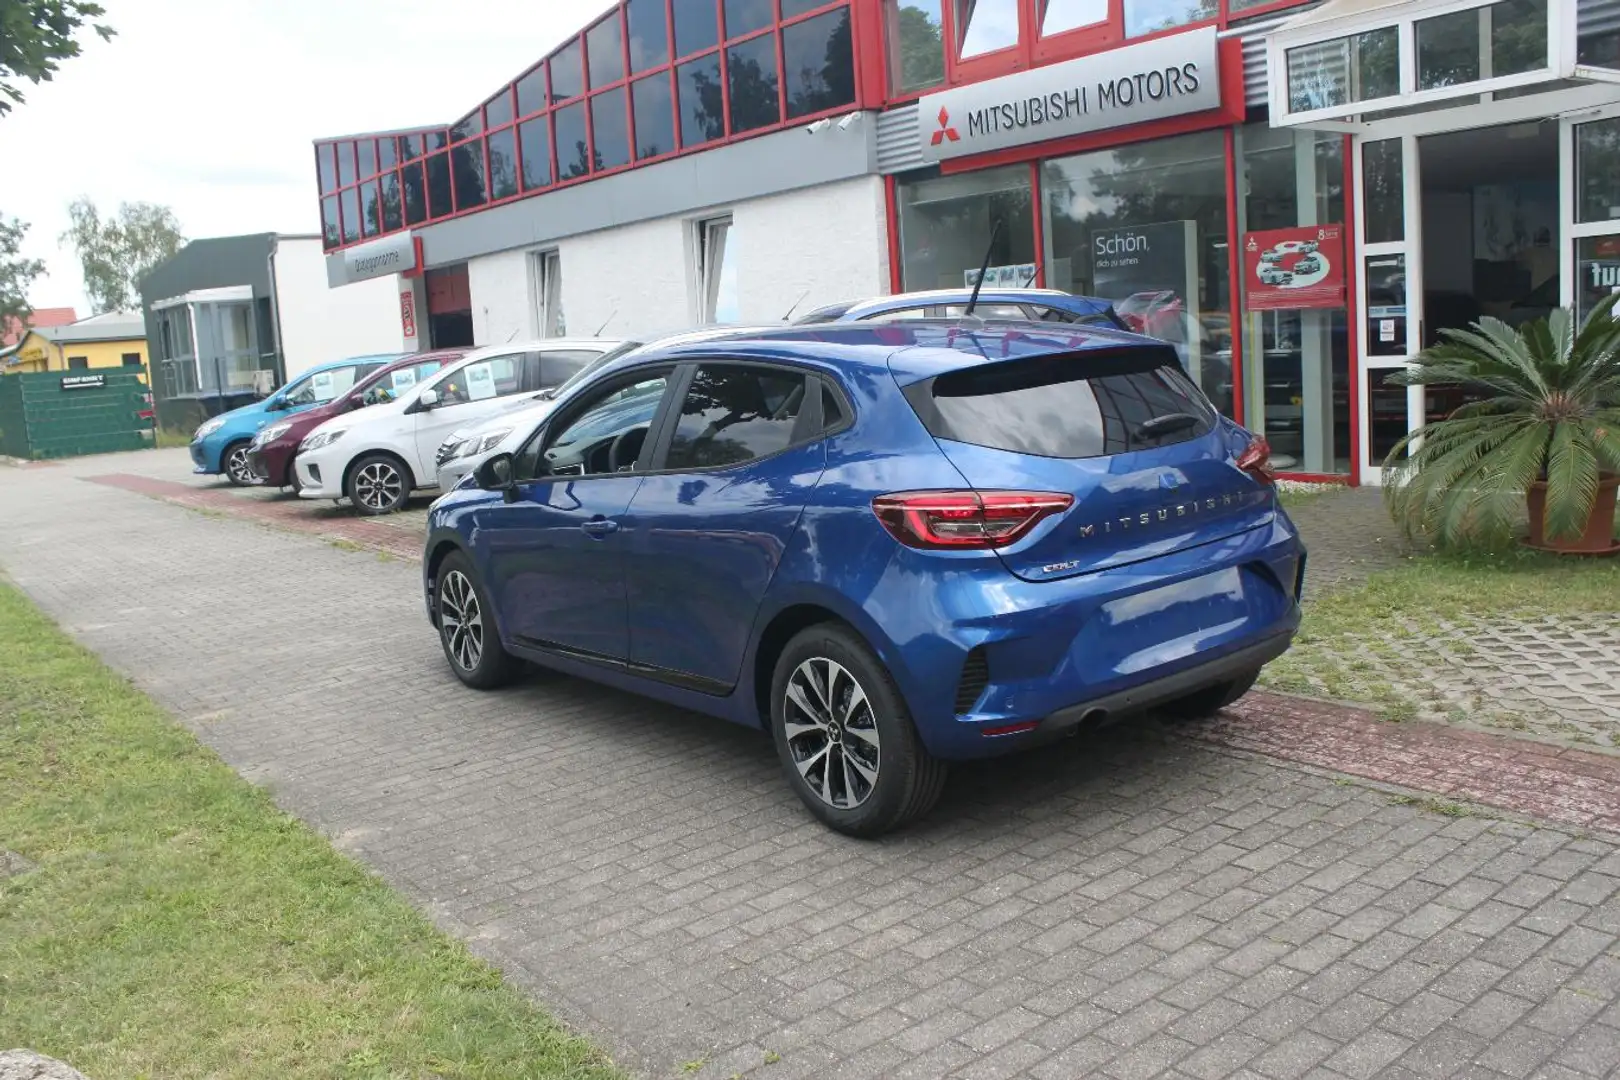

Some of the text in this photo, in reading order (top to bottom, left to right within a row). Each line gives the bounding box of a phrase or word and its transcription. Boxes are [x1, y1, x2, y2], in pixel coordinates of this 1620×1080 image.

[967, 62, 1200, 137] MITSUBISHI MOTORS
[1096, 232, 1150, 255] Schön,
[1591, 262, 1620, 287] fu
[1080, 491, 1244, 538] MITSUBISHI
